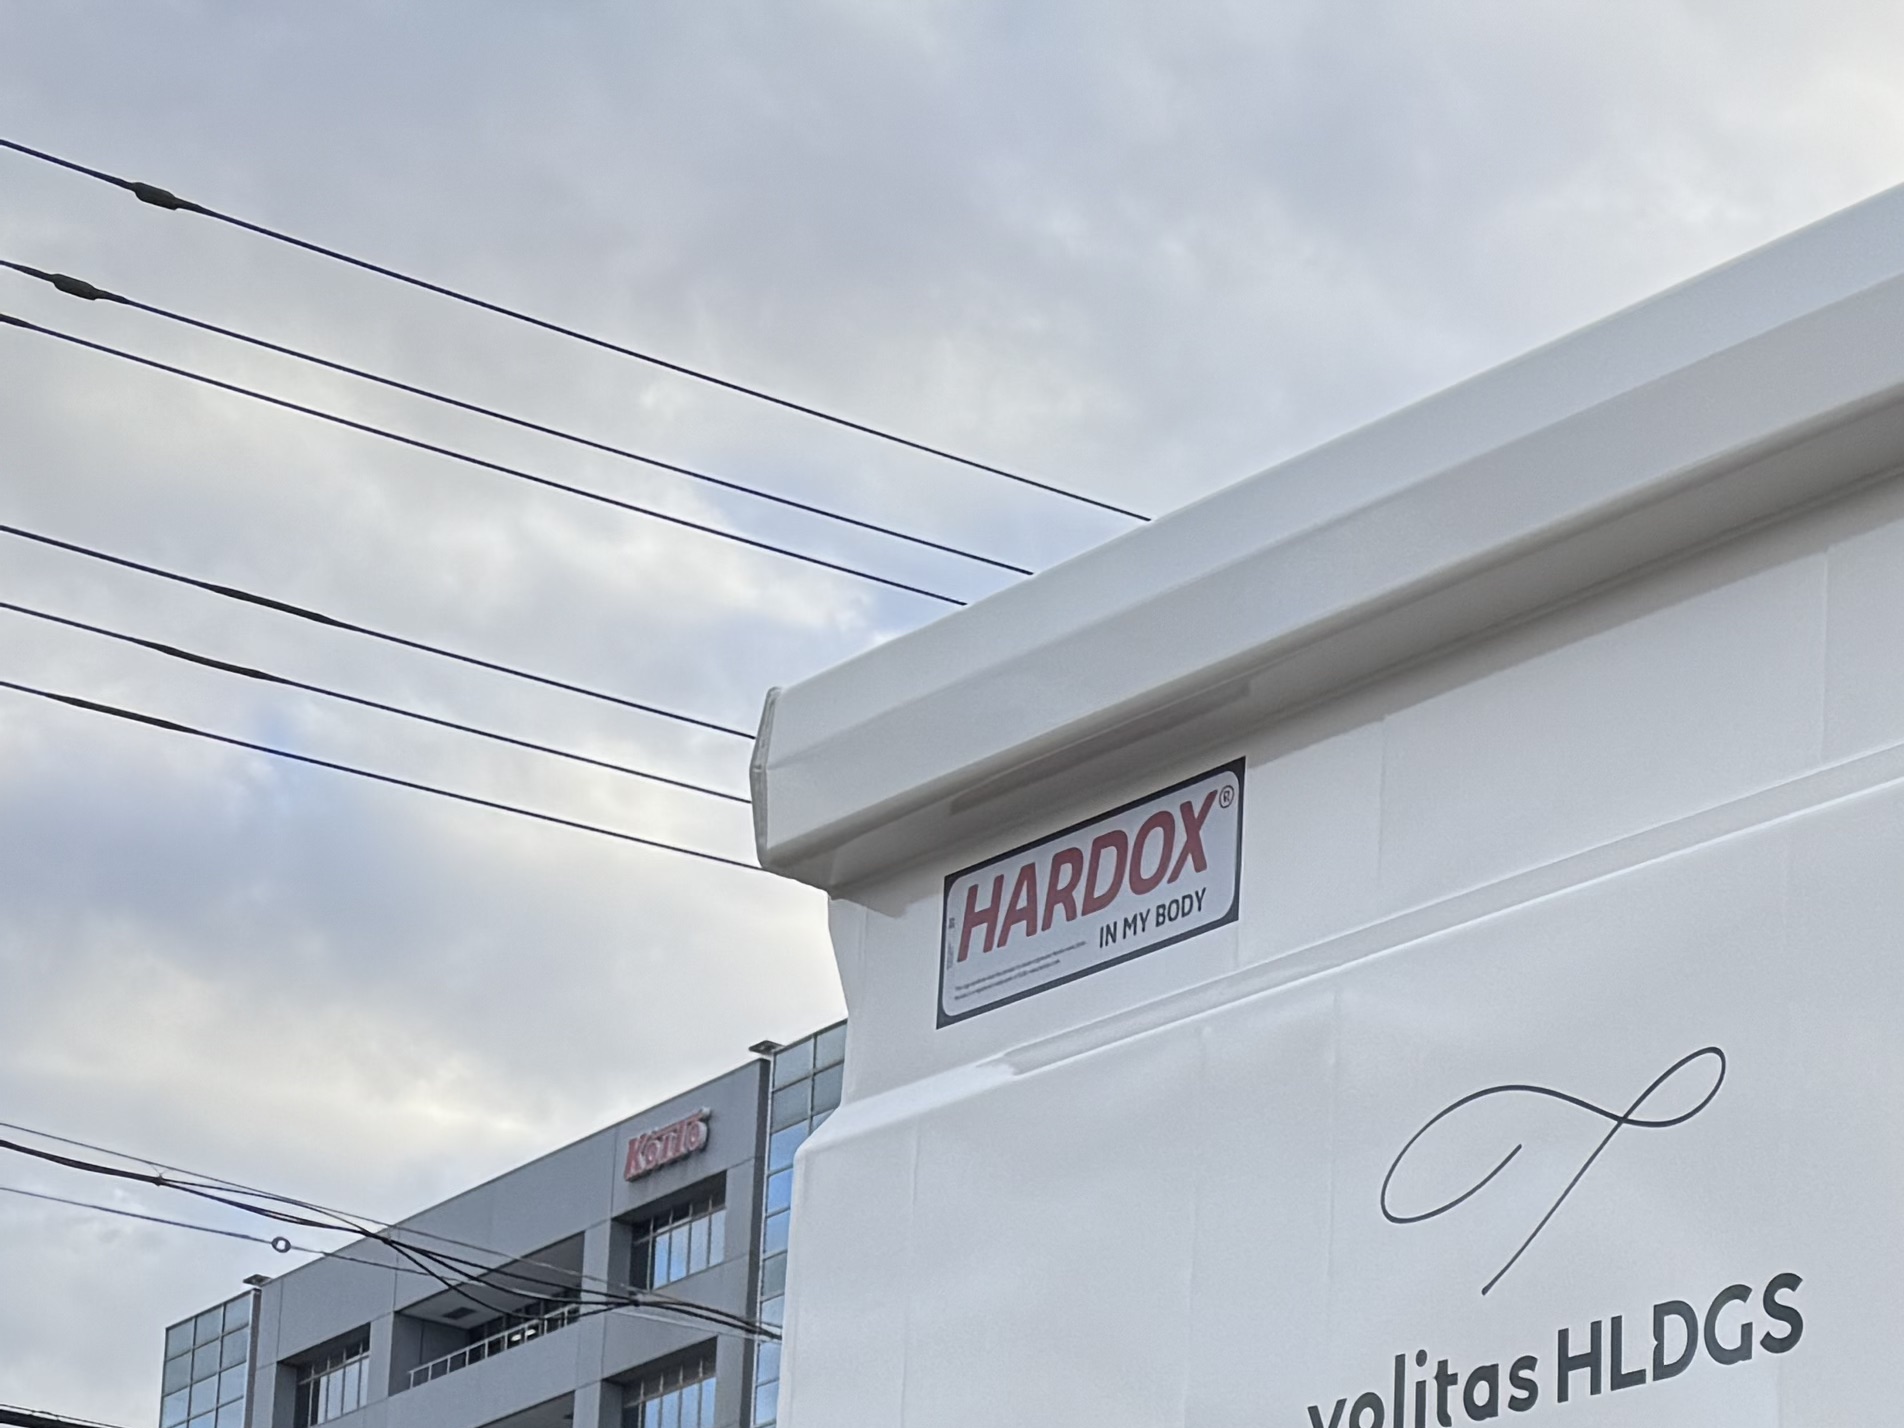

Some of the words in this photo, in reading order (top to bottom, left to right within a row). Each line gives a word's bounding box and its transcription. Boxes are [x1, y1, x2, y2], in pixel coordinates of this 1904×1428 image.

[1099, 920, 1119, 949] IN
[1121, 907, 1152, 941] MY
[1154, 886, 1208, 928] BODY
